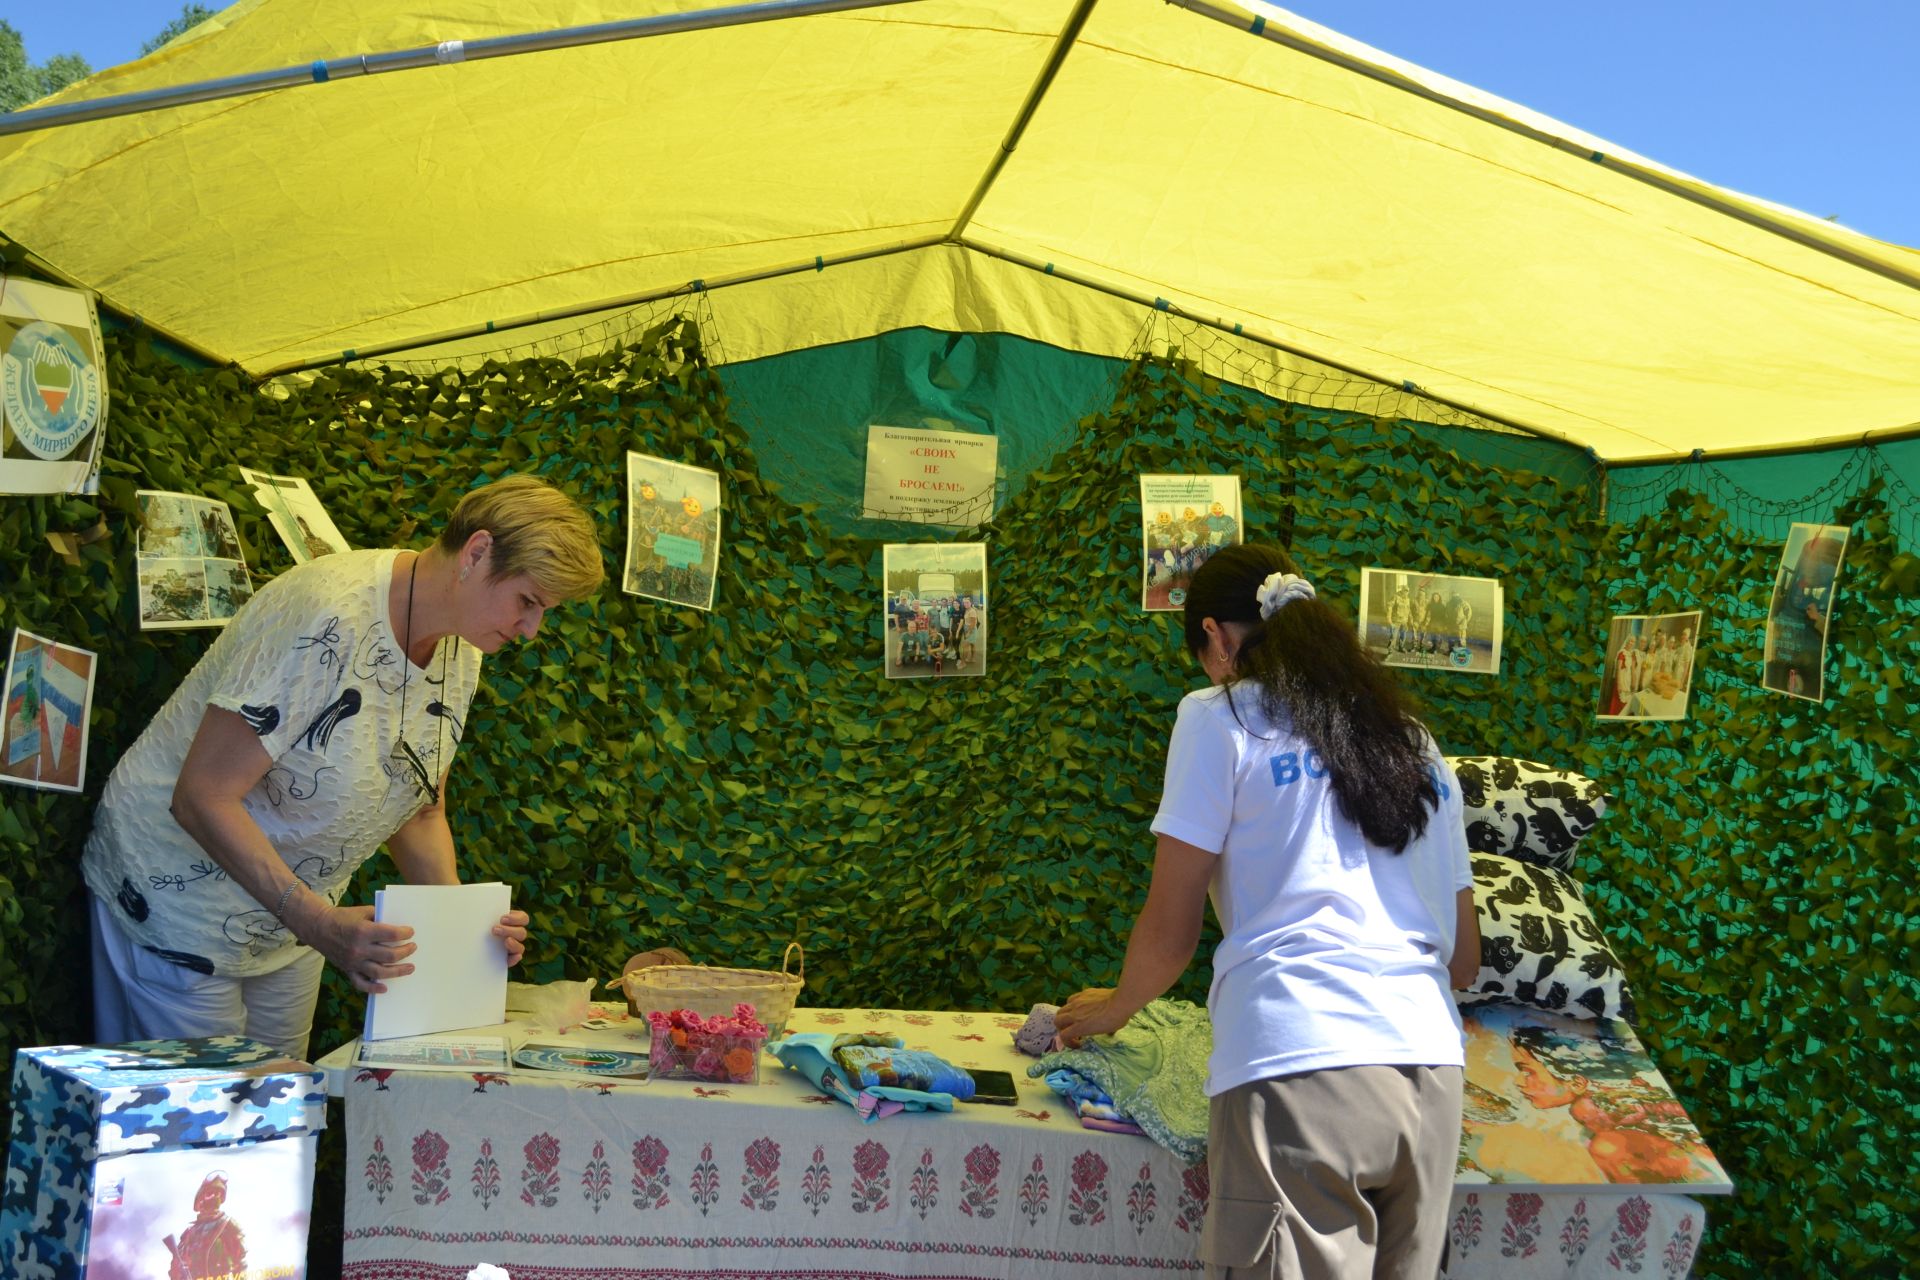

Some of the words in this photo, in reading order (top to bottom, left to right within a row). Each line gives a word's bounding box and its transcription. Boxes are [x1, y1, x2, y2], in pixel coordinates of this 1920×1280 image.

[6, 361, 33, 438] ЖЕЛАЕМ
[32, 419, 88, 452] МИРНОГО
[86, 372, 97, 417] НЕБА
[884, 432, 951, 444] Благотворительная
[910, 447, 956, 459] «СВОИХ
[924, 464, 940, 474] НЕ
[900, 479, 965, 493] БРОСАЕМ!»
